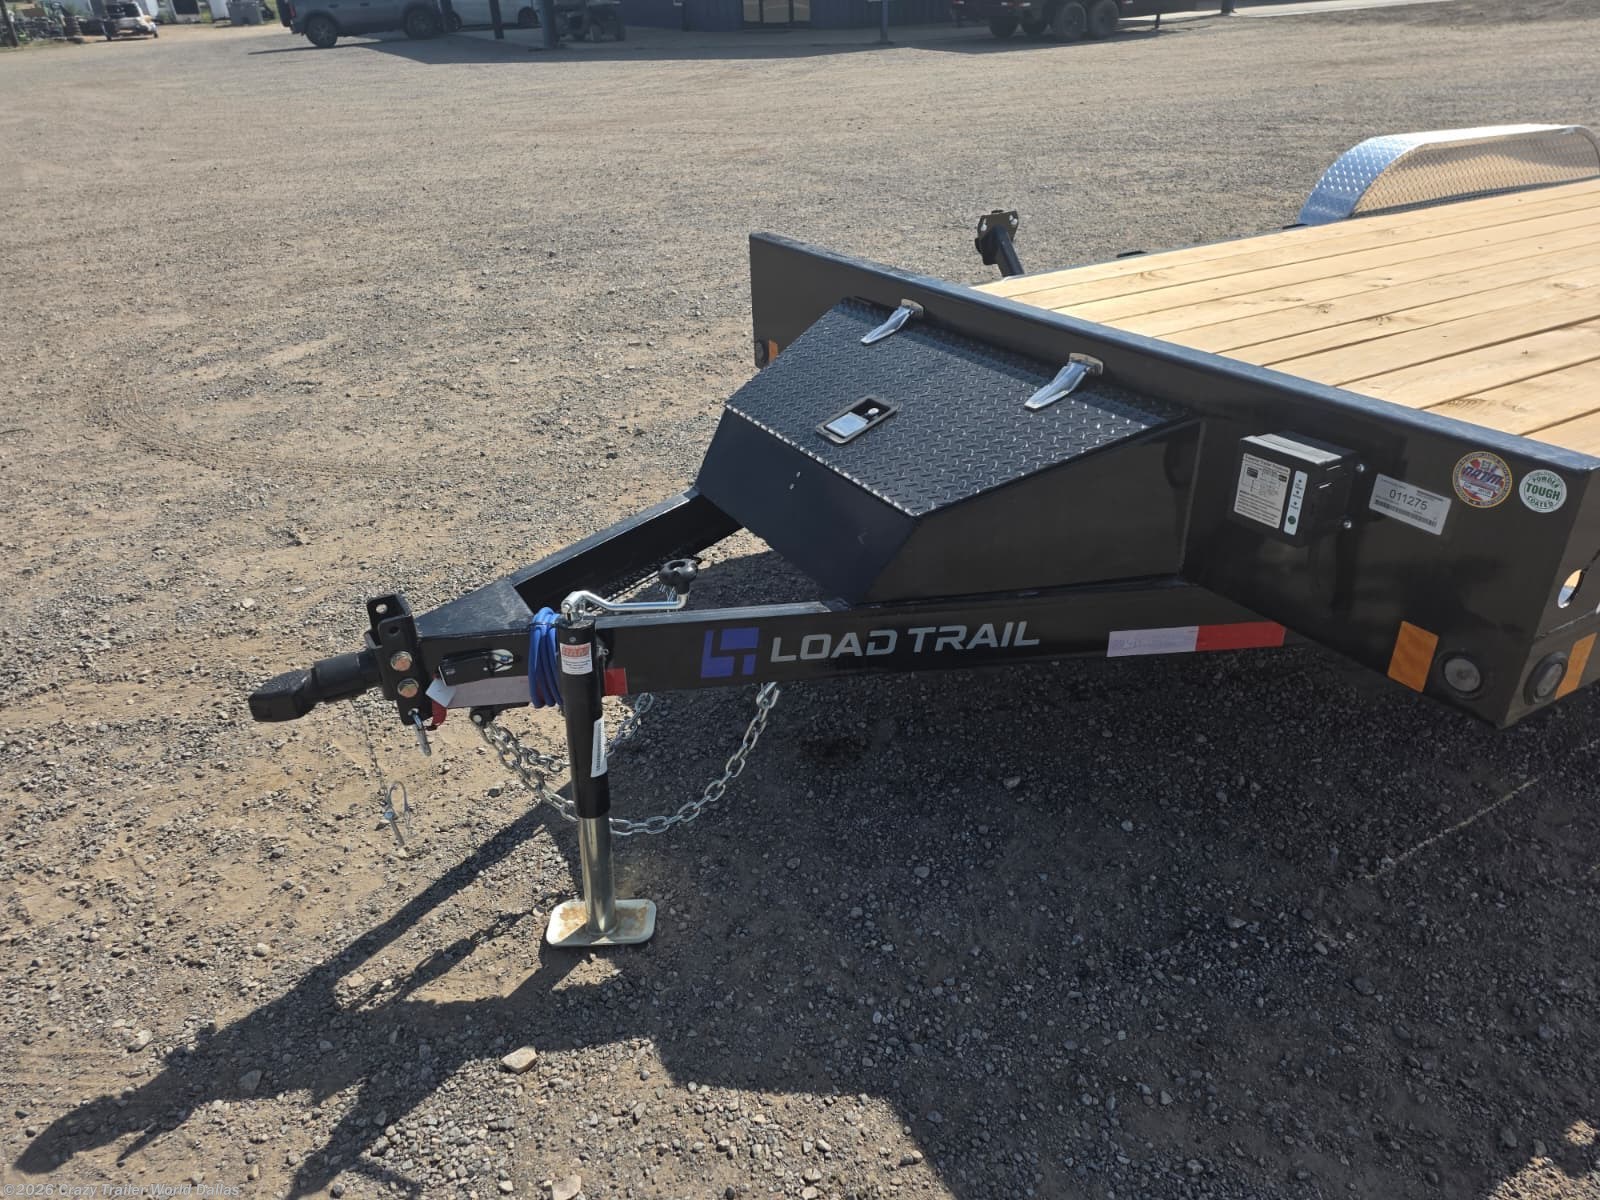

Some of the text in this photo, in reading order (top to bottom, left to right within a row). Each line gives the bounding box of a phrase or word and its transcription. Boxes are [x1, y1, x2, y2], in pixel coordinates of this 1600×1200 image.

[1389, 489, 1428, 511] 011275
[1526, 482, 1561, 501] TOUGH
[770, 620, 1041, 663] LOAD TRAIL
